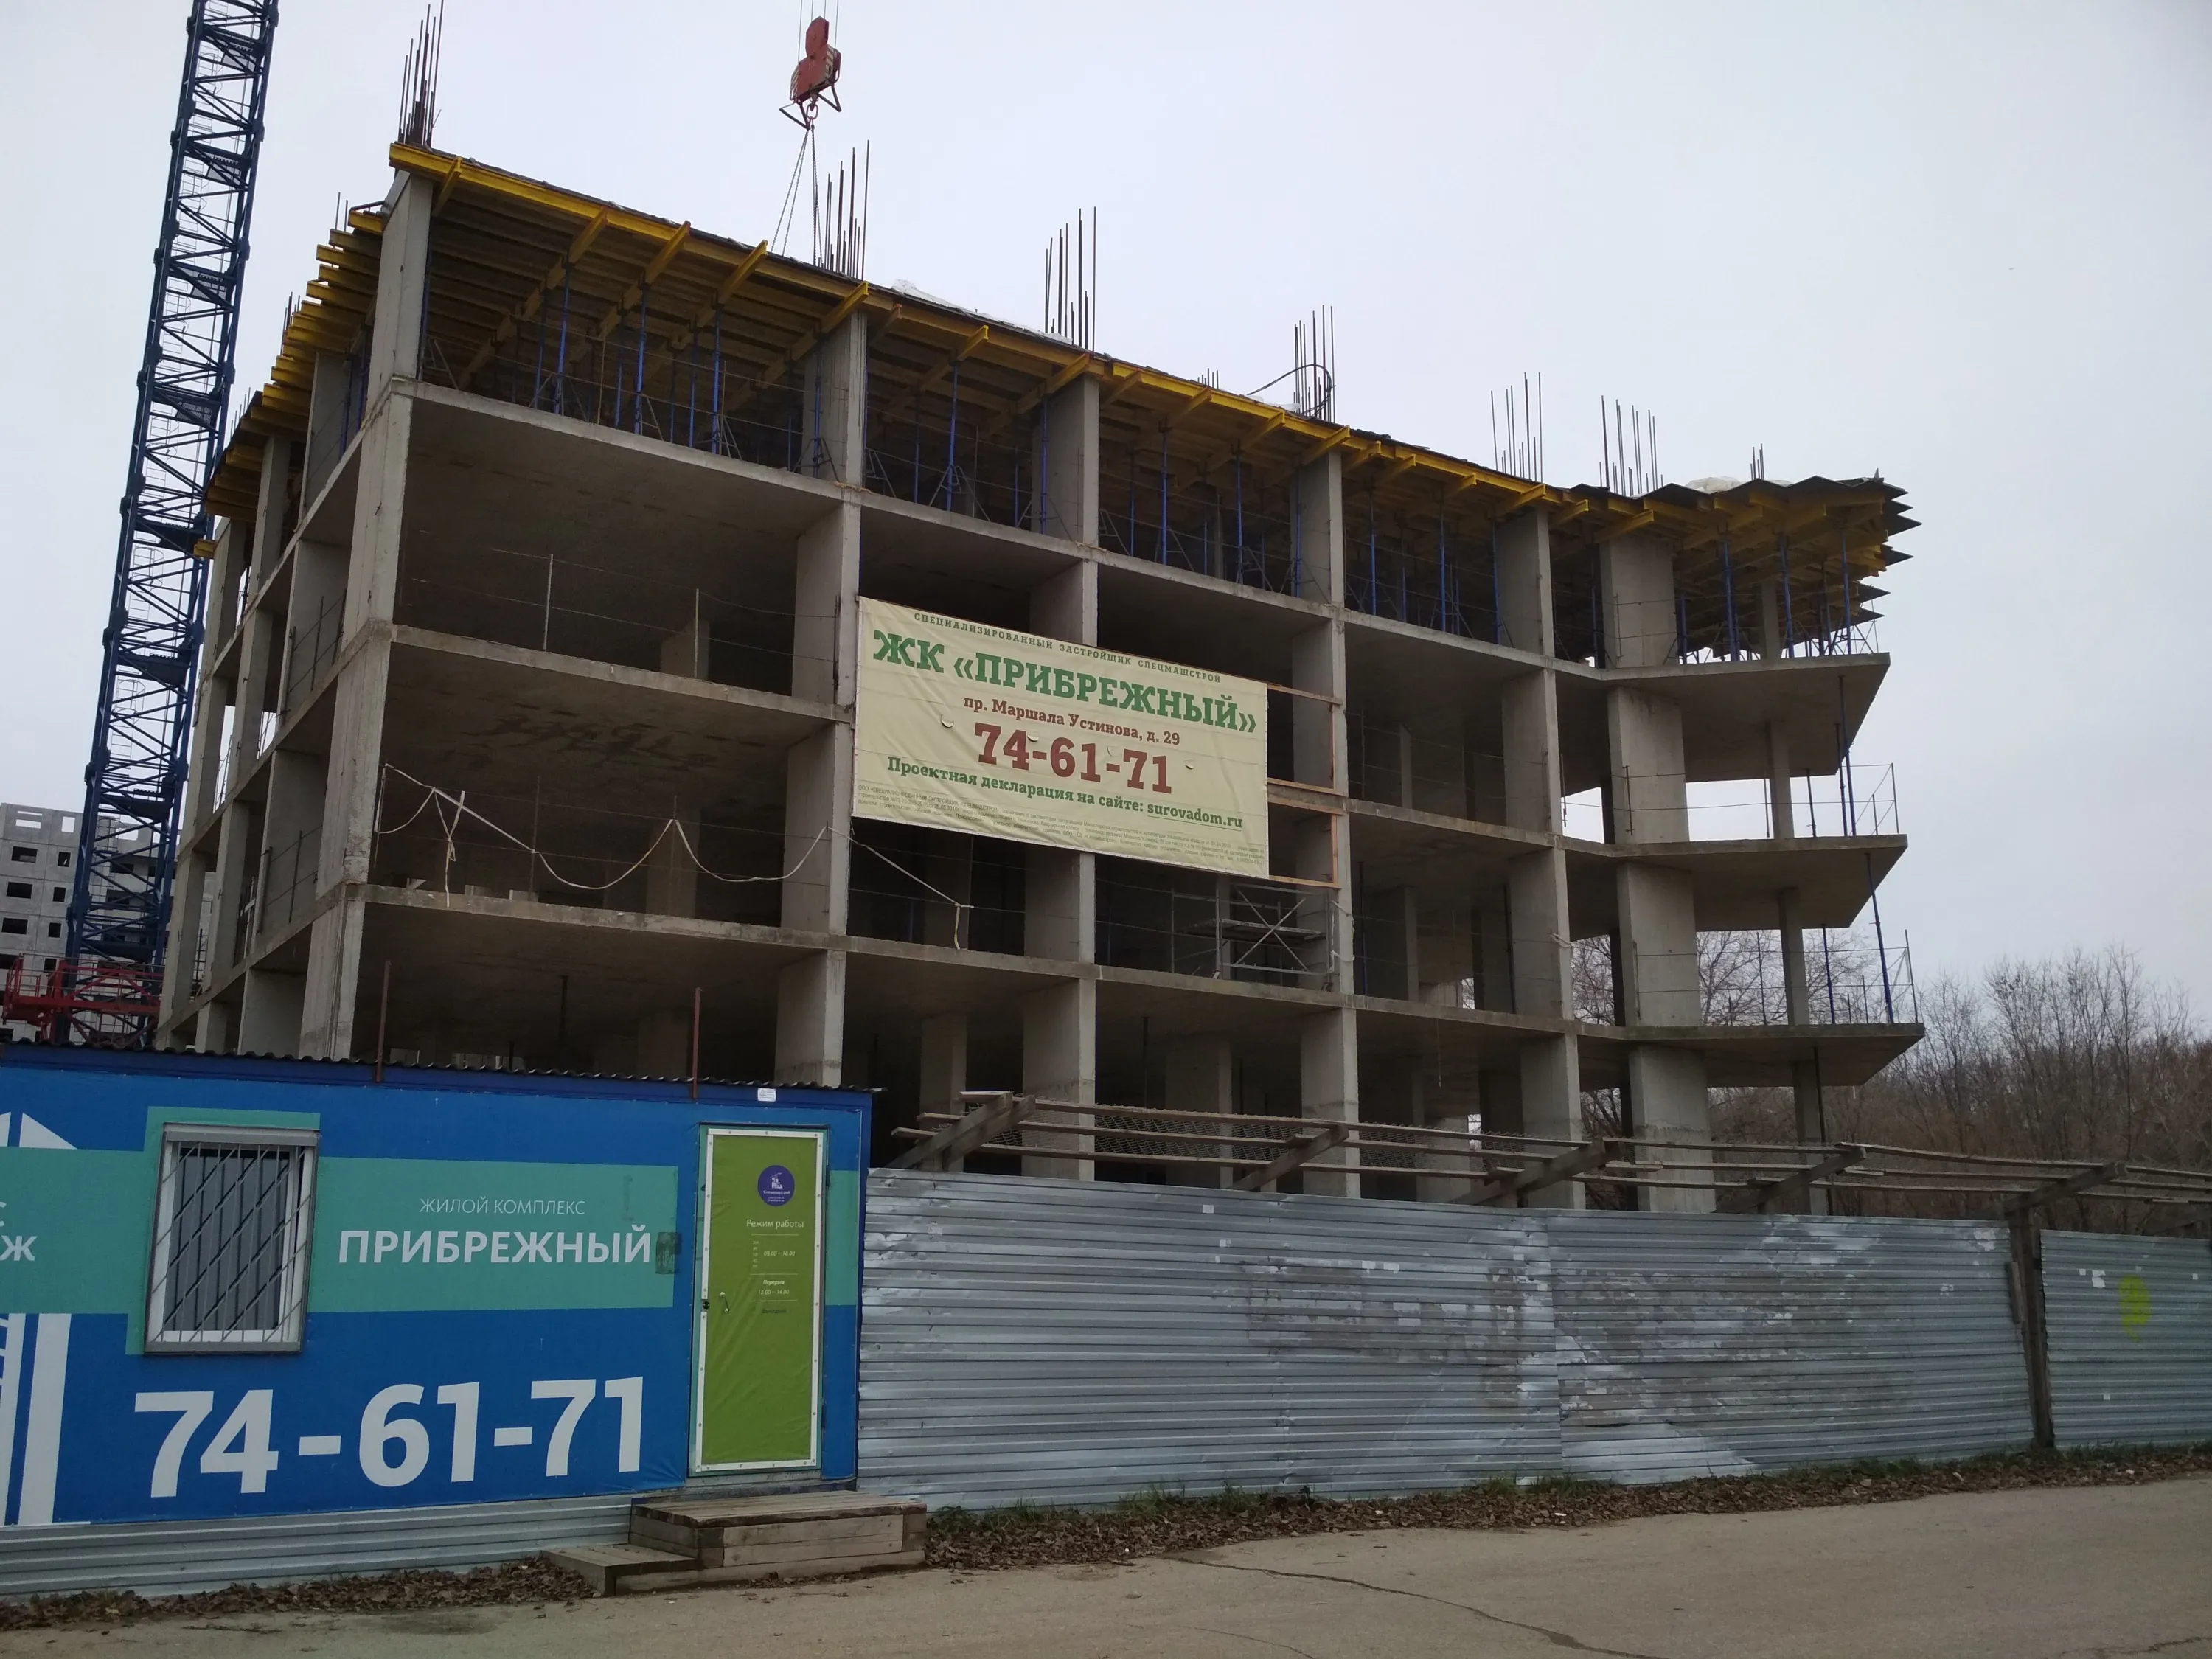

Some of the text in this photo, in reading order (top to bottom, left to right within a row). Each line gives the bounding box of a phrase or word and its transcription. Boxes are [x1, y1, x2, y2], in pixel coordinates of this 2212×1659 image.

[873, 630, 1256, 733] ЖК «ПРИБРЕЖНЫЙ»
[914, 613, 1221, 684] СПЕЦИАЛИЗИРОВАННЫЙ ЗАСТРОЙЩИК СПЕЦМАШСТРОЙ
[964, 697, 1180, 745] пр. Маршала Устинова, д. 29
[888, 756, 1243, 829] Проектная декларация на сайте: surovadom.ru
[974, 722, 1172, 794] 74-61-71
[419, 1196, 586, 1215] ЖИЛОЙ КОМПЛЕКС
[746, 1219, 804, 1230] Режим работы
[338, 1224, 651, 1264] ПРИБРЕЖНЫЙ
[135, 1377, 644, 1498] 74-61-71
